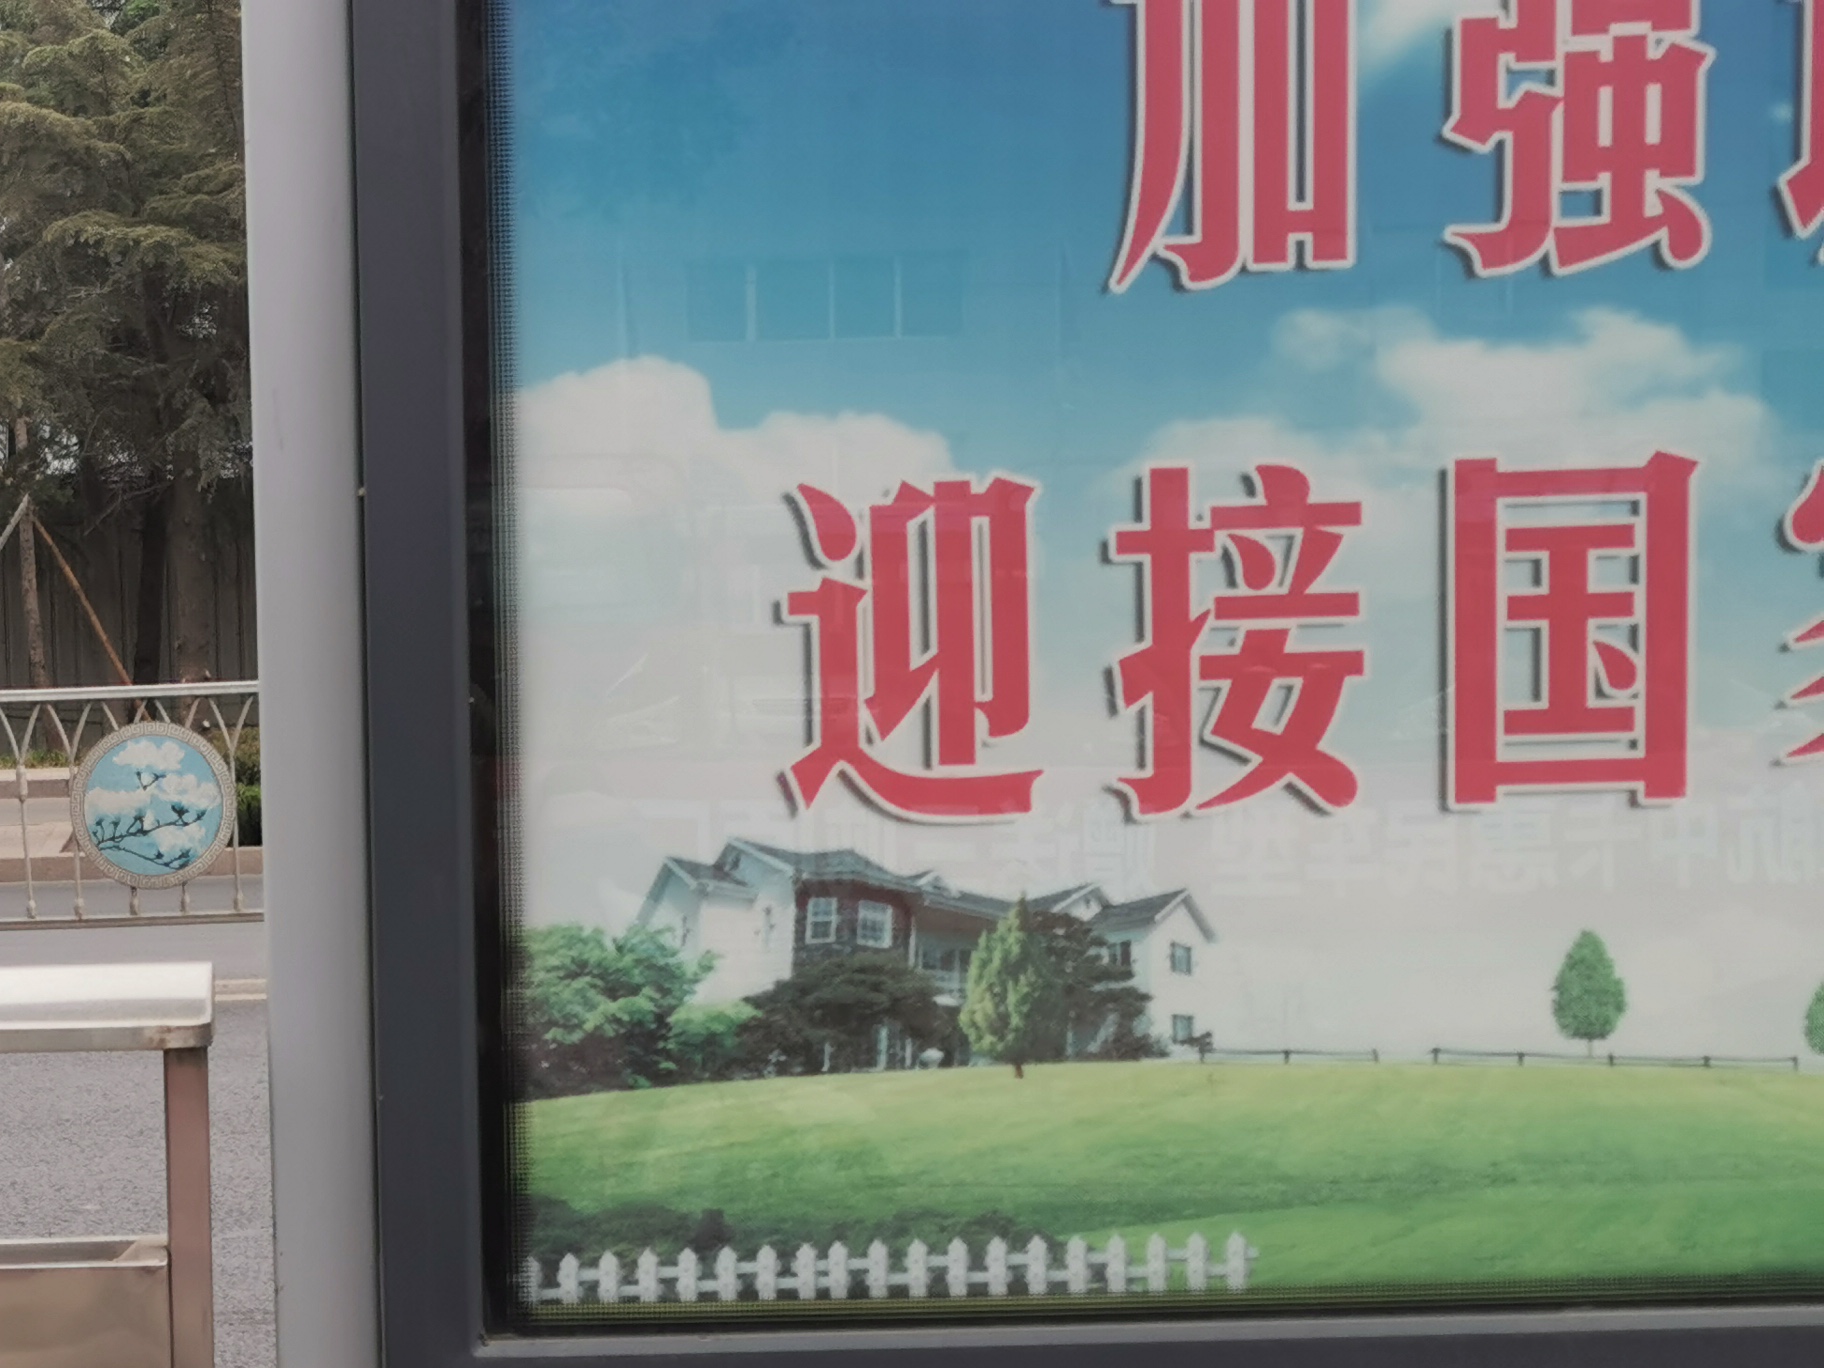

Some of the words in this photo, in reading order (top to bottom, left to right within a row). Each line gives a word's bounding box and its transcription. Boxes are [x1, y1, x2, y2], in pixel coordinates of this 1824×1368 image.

[1105, 0, 1824, 293] 加强
[778, 450, 1824, 822] 迎接国
